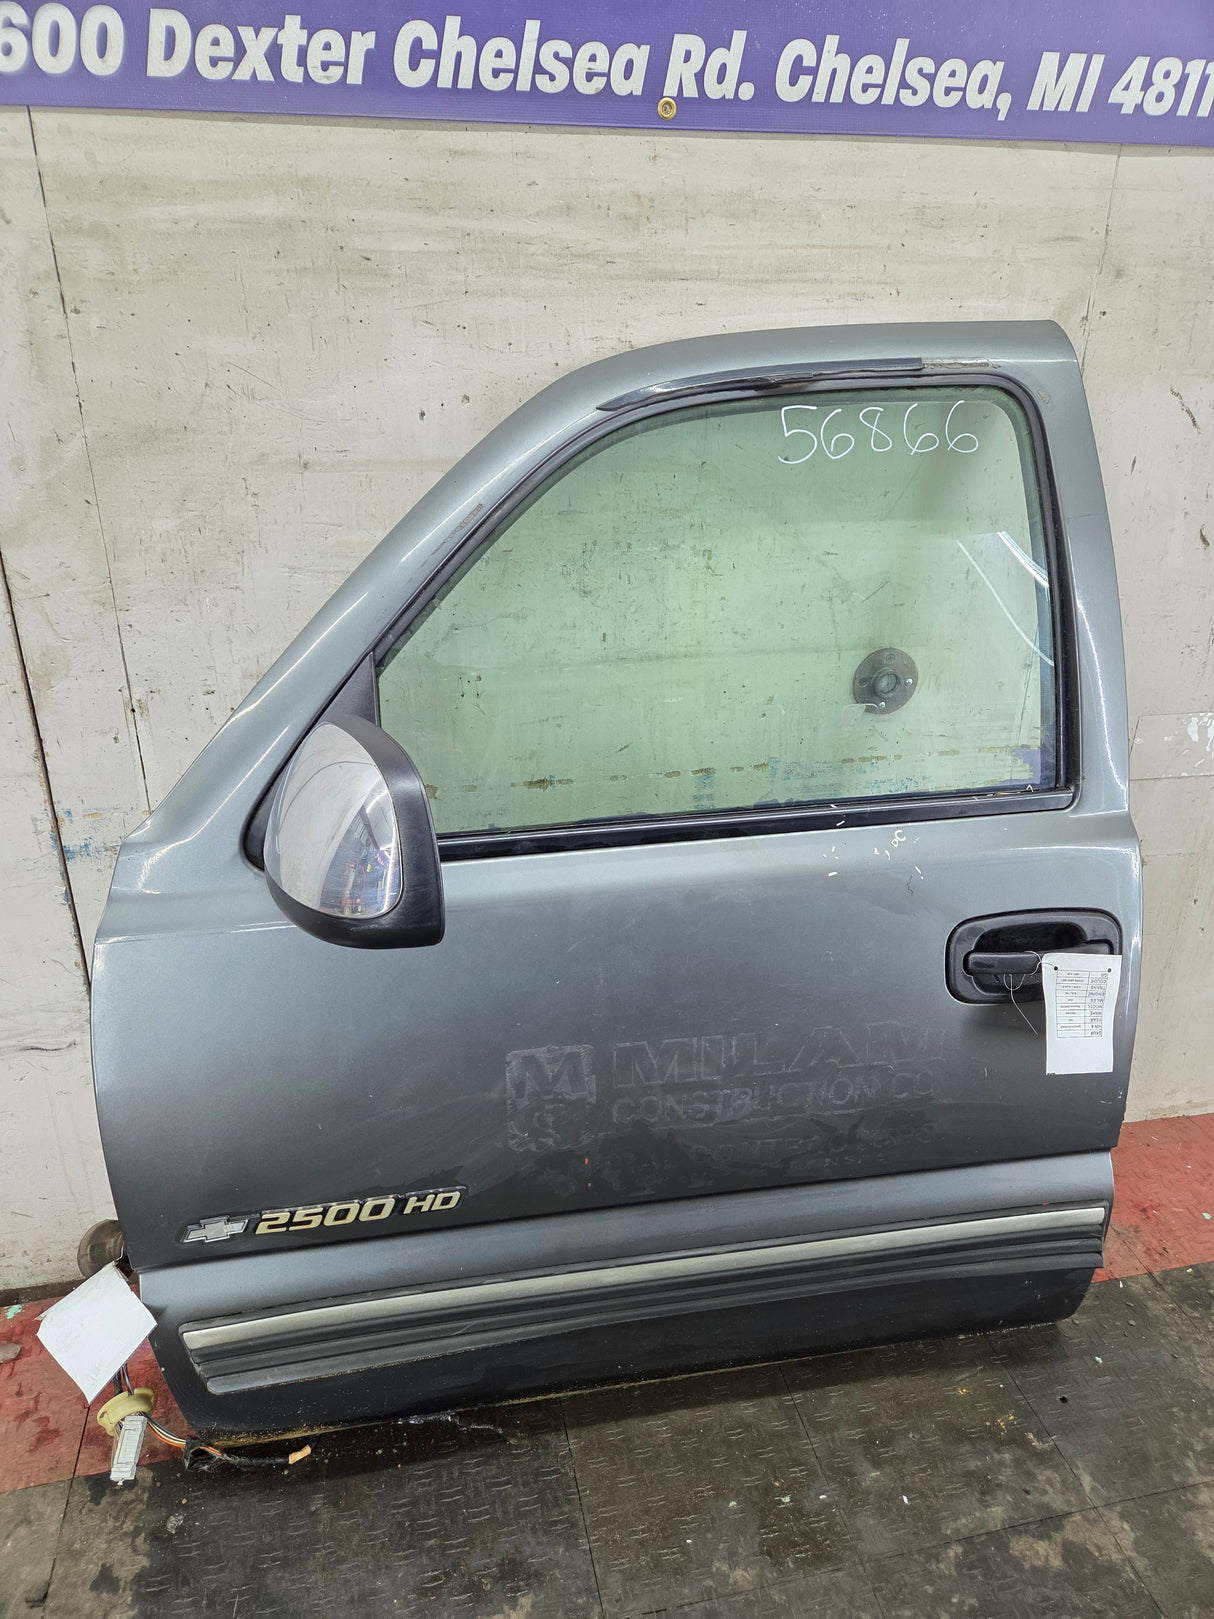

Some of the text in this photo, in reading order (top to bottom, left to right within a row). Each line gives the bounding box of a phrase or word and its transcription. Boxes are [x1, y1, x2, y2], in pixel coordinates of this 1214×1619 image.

[0, 1, 1214, 121] 600 Dexter Chelsea Rd. Chelsea, MI 4811
[778, 400, 979, 464] 56866
[254, 1191, 461, 1235] 2500 HD
